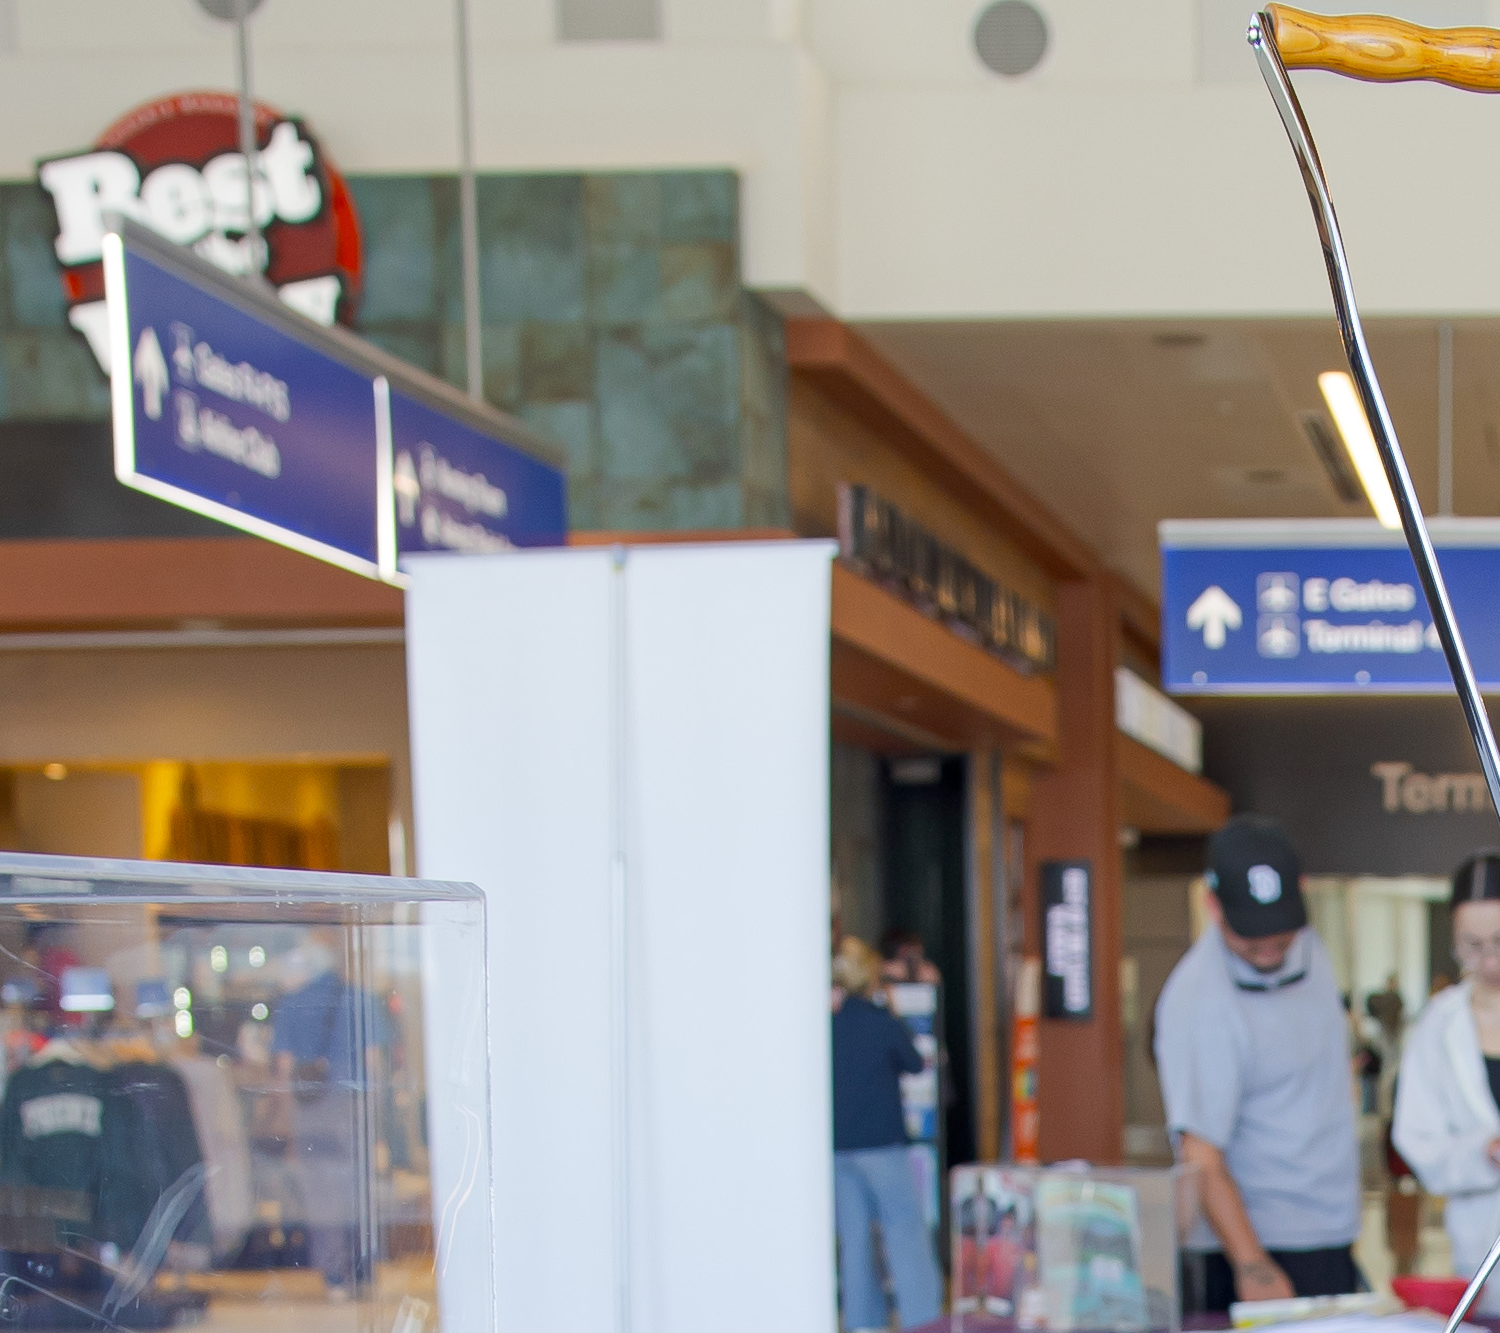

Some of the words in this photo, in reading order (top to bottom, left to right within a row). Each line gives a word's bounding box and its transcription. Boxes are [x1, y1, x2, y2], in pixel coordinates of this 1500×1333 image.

[1303, 577, 1330, 612] E
[1330, 577, 1417, 612] Gates
[1303, 619, 1422, 653] Terminal
